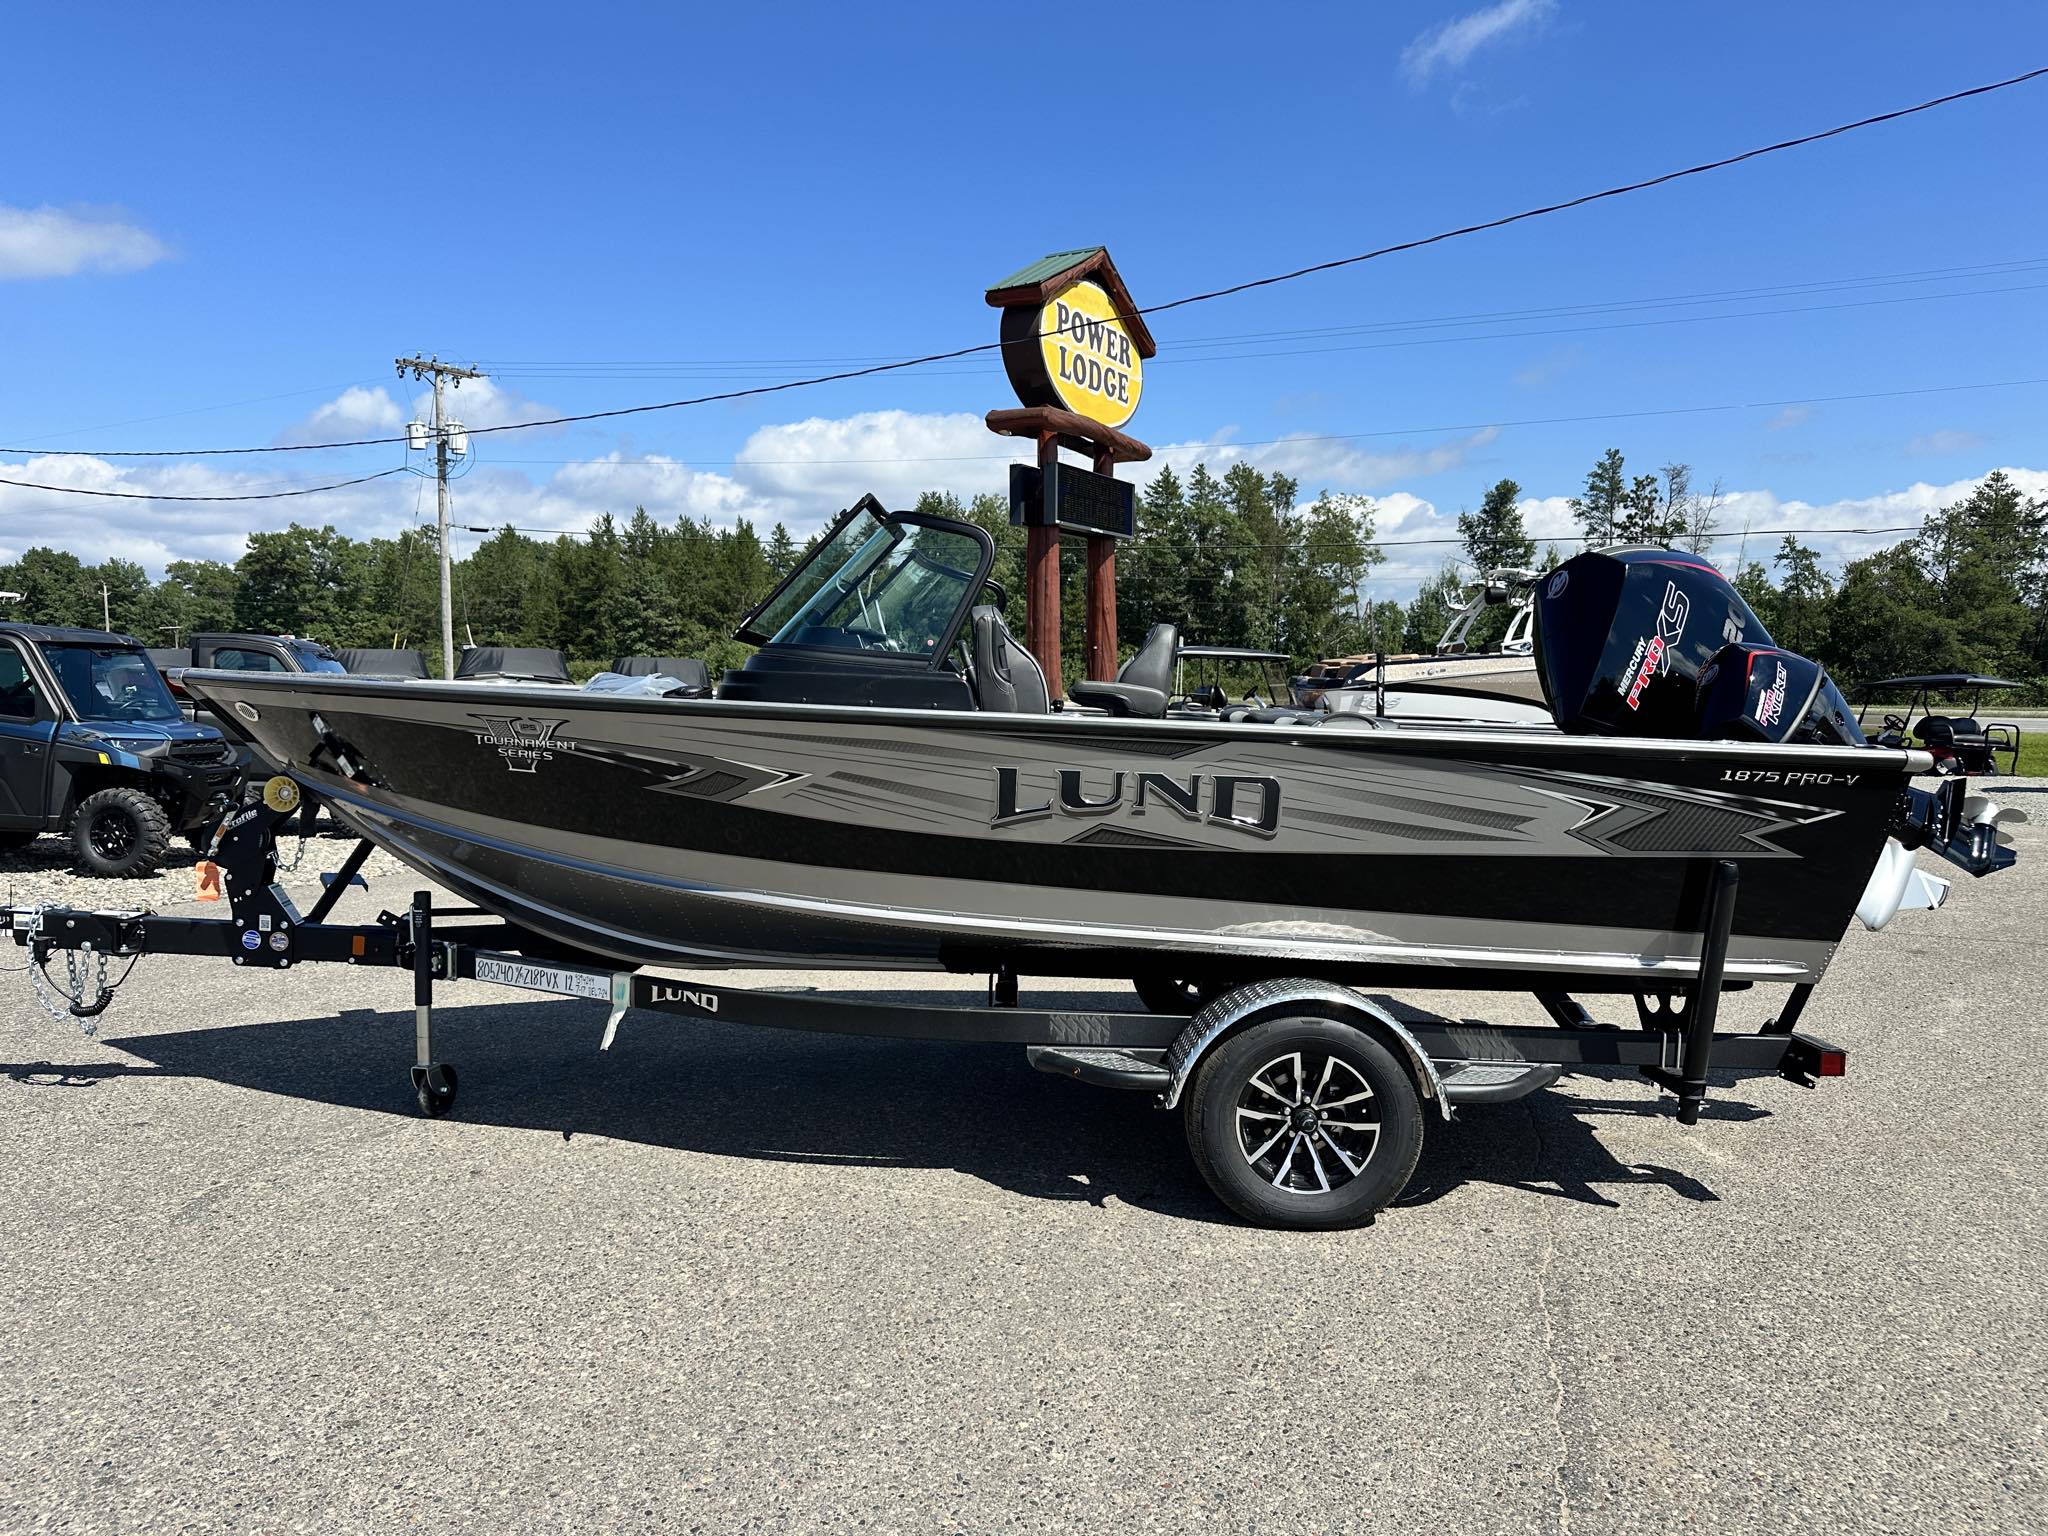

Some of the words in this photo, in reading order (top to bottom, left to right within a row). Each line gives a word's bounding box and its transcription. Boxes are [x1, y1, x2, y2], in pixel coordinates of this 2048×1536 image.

[1056, 302, 1131, 368] POWER
[1059, 345, 1128, 404] LODGE
[1626, 635, 1665, 711] PRO
[1656, 580, 1690, 678] XS
[1617, 636, 1647, 696] MERCURY
[474, 734, 578, 751] TOURNAMENT
[497, 748, 554, 761] SERIES
[1719, 769, 1782, 783] 1875
[1783, 772, 1861, 786] PRO-V
[990, 766, 1281, 840] LUND
[229, 809, 258, 829] rofile
[477, 960, 514, 983] 805240
[564, 974, 574, 991] 12
[650, 984, 719, 1013] LUND
